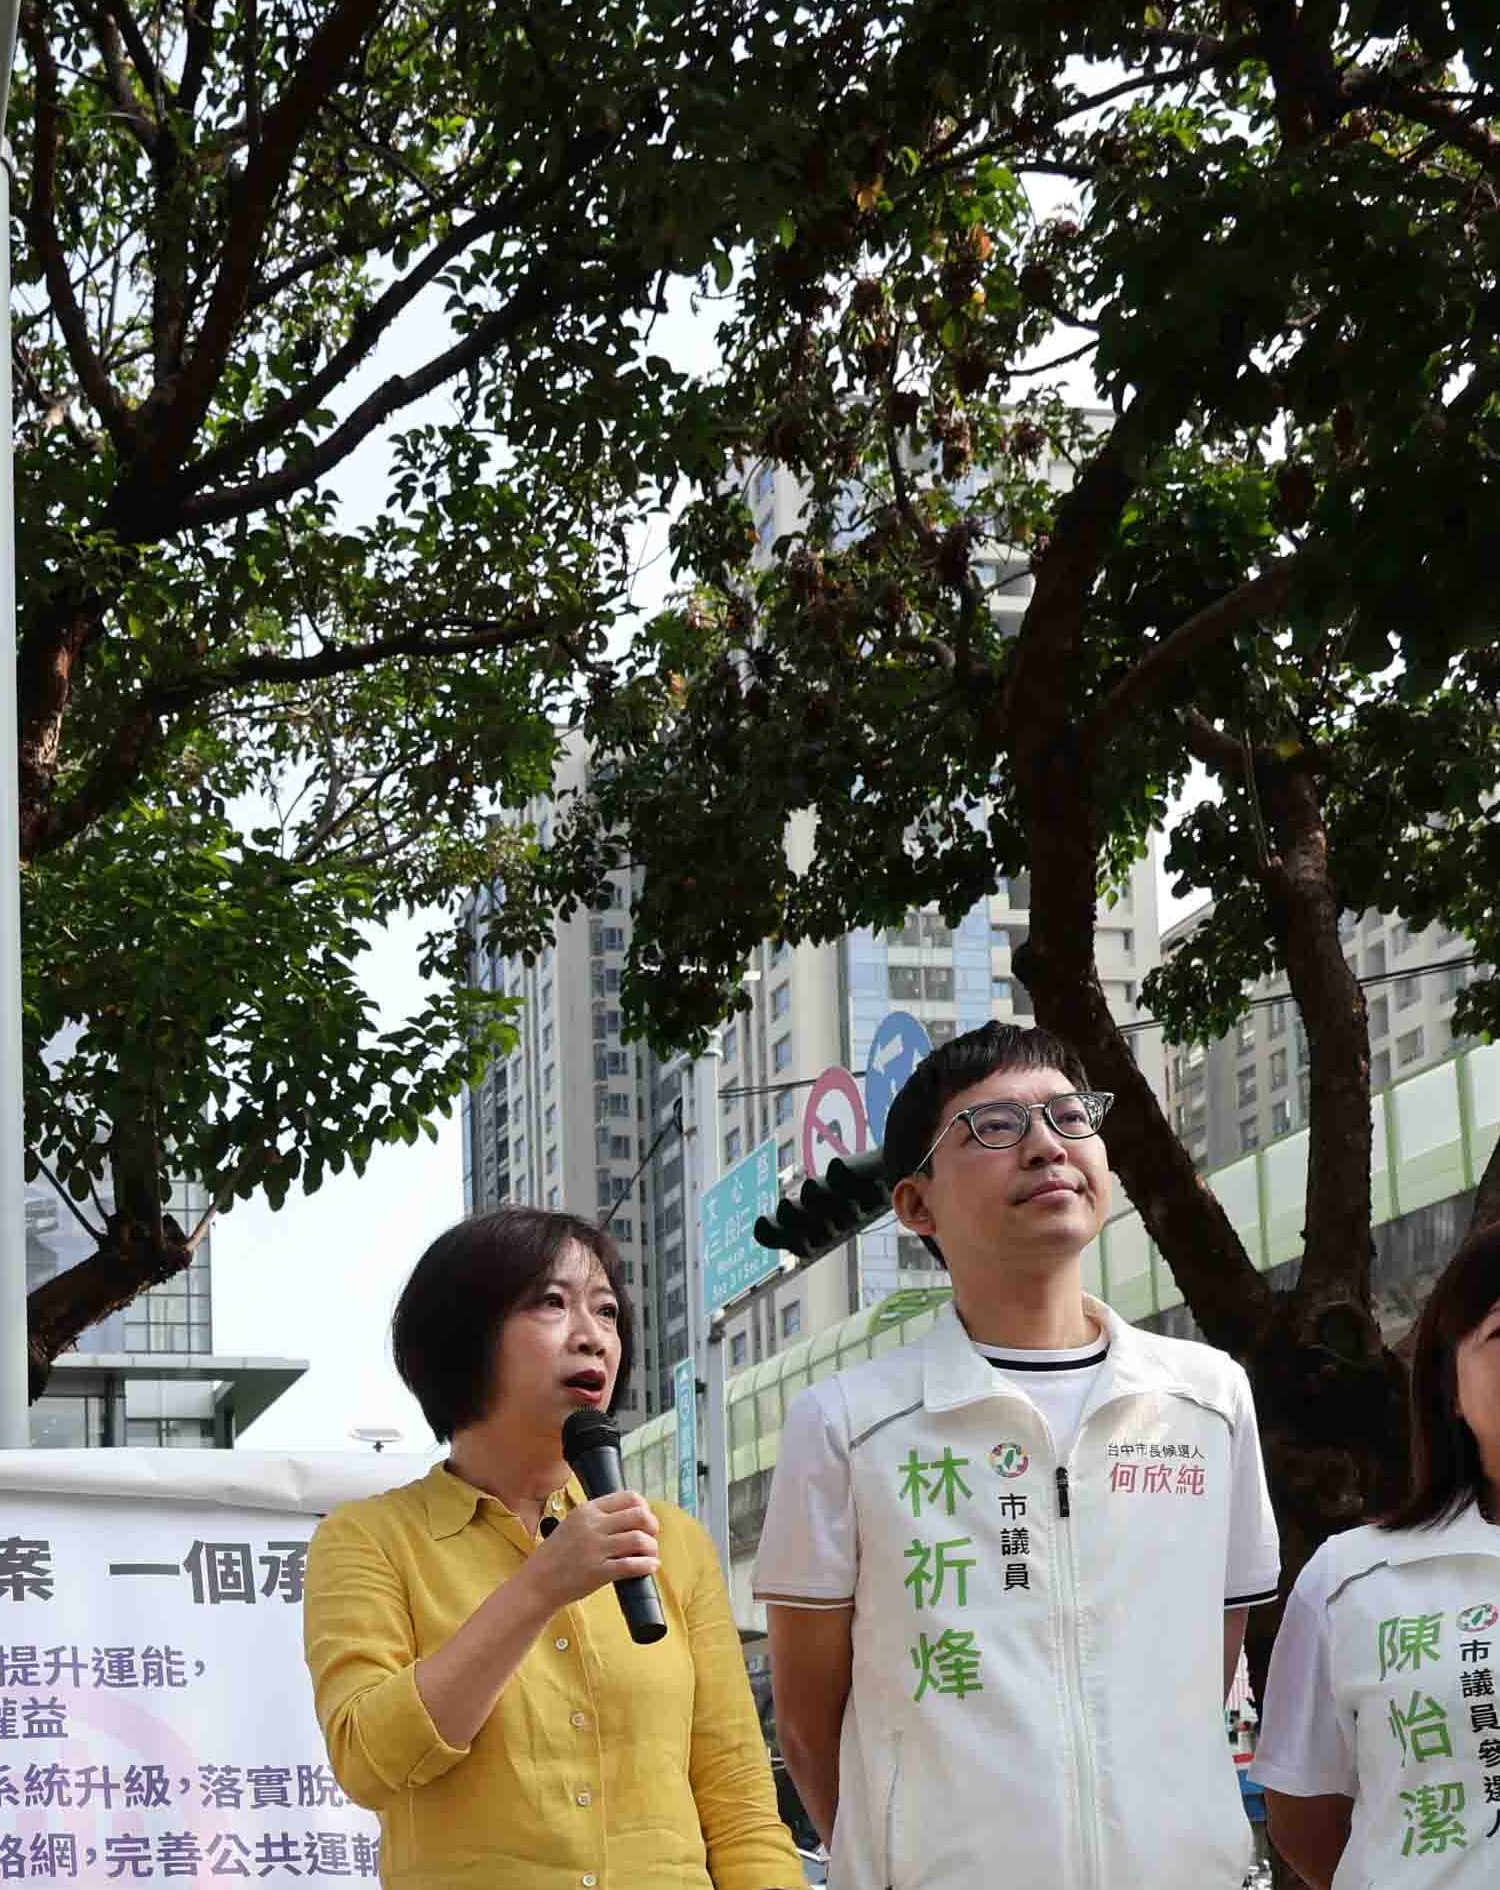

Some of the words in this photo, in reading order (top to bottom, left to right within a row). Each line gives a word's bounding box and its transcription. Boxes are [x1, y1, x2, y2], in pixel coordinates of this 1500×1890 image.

[1108, 1443, 1204, 1461] 台中市長候選人
[1110, 1462, 1206, 1496] 何欣純
[109, 1539, 307, 1605] 一個承
[899, 1446, 984, 1702] 林祈烽
[998, 1493, 1030, 1591] 市議員
[1377, 1612, 1466, 1857] 陳怡潔
